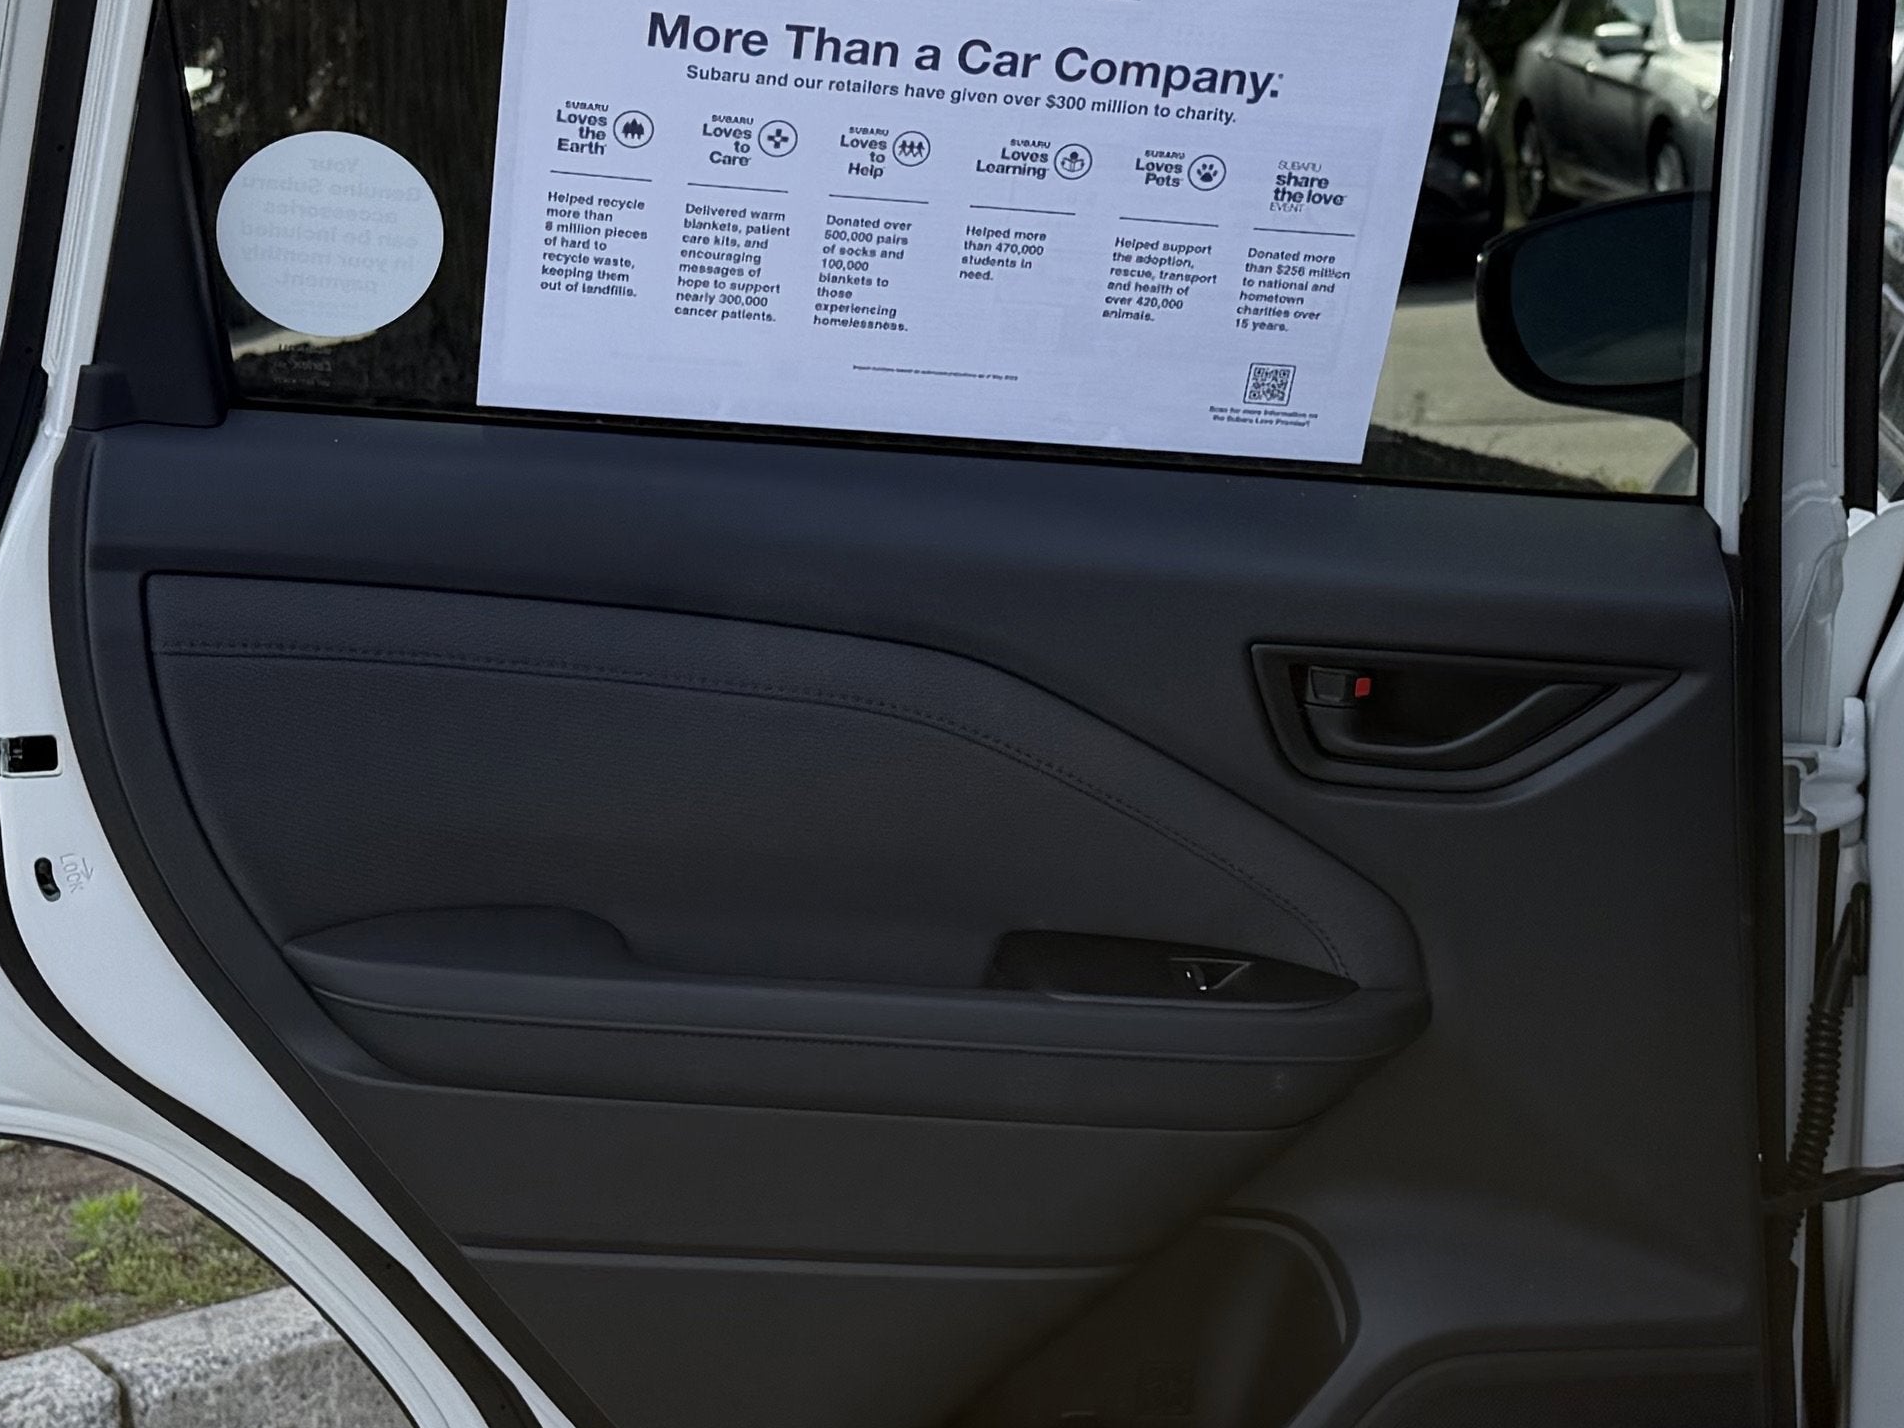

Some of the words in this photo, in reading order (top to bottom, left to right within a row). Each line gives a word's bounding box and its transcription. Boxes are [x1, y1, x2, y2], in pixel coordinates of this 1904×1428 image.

[648, 12, 768, 57] More
[786, 24, 899, 68] Than
[915, 45, 941, 71] a
[958, 39, 1041, 78] Car
[687, 65, 750, 83] Subaru
[755, 73, 788, 87] and
[794, 77, 823, 89] our
[829, 79, 899, 96] retailers
[904, 84, 945, 99] have
[950, 88, 997, 104] given
[1003, 94, 1041, 107] over
[1045, 94, 1086, 111] $300
[1091, 99, 1148, 116] million
[1154, 103, 1170, 117] to
[1176, 105, 1235, 125] charity.
[565, 101, 609, 112] SUBARU
[557, 109, 607, 127] Loves
[712, 115, 754, 125] SUBARU
[578, 126, 606, 140] the
[703, 123, 752, 140] Loves
[849, 127, 889, 137] SUBARU
[557, 138, 607, 155] Earth
[734, 141, 750, 153] to
[840, 134, 887, 151] Loves
[1010, 139, 1051, 149] SUBARU
[709, 152, 751, 166] Care
[869, 151, 885, 163] to
[1001, 147, 1048, 163] Loves
[1145, 150, 1185, 160] SUBARU
[848, 162, 885, 179] Help
[976, 160, 1050, 180] Learning
[1135, 158, 1183, 174] Loves
[1278, 160, 1322, 173] SUBARU
[1145, 173, 1183, 187] Pets
[1276, 171, 1329, 189] share
[548, 191, 594, 206] Helped
[598, 198, 645, 210] recycle
[1274, 187, 1304, 203] the
[1306, 189, 1347, 206] love
[547, 208, 580, 219] more
[584, 209, 613, 222] than
[686, 203, 747, 218] Delivered
[751, 211, 785, 221] warm
[1270, 202, 1305, 212] EVENT
[557, 222, 601, 236] million
[604, 226, 647, 239] pieces
[684, 218, 742, 234] blankets,
[745, 224, 790, 236] patient
[826, 214, 880, 228] Donated
[884, 221, 912, 231] over
[825, 229, 873, 243] 500,000
[876, 234, 908, 246] pairs
[966, 225, 1010, 240] Helped
[1014, 231, 1046, 241] more
[544, 236, 557, 246] of
[561, 236, 590, 250] hard
[594, 240, 607, 251] to
[682, 235, 710, 245] care
[713, 235, 740, 249] kits,
[744, 239, 768, 249] and
[964, 240, 992, 252] than
[995, 242, 1044, 256] 470,000
[1115, 237, 1160, 251] Helped
[1162, 243, 1212, 256] support
[681, 249, 761, 265] encouraging
[823, 244, 836, 254] of
[839, 246, 876, 258] socks
[880, 250, 904, 259] and
[1248, 248, 1300, 261] Donated
[1303, 254, 1335, 264] more
[543, 252, 590, 265] recycle
[593, 256, 634, 269] waste,
[822, 258, 869, 271] 100,000
[962, 255, 1016, 268] students
[1021, 258, 1032, 269] in
[1113, 252, 1133, 263] the
[1135, 254, 1194, 270] adoption,
[542, 264, 593, 281] keeping
[597, 269, 629, 282] them
[679, 264, 744, 278] messages
[748, 268, 761, 278] of
[959, 270, 993, 280] need.
[1110, 268, 1156, 281] rescue,
[1159, 270, 1217, 285] transport
[1245, 262, 1273, 274] than
[1308, 267, 1350, 279] million
[677, 276, 710, 290] hope
[714, 279, 726, 290] to
[729, 282, 780, 295] support
[819, 272, 872, 286] blankets
[877, 277, 889, 287] to
[1243, 277, 1255, 287] to
[1258, 279, 1309, 291] national
[1311, 283, 1335, 293] and
[540, 281, 561, 290] out
[565, 281, 579, 292] of
[582, 282, 636, 297] landfills.
[817, 286, 852, 299] those
[1107, 280, 1132, 291] and
[1134, 281, 1173, 295] health
[1176, 286, 1190, 296] of
[676, 292, 716, 305] nearly
[719, 293, 768, 307] 300,000
[1105, 296, 1133, 306] over
[1136, 296, 1183, 309] 420,000
[1239, 290, 1304, 305] hometown
[674, 307, 718, 317] cancer
[721, 309, 776, 321] patients.
[815, 303, 896, 319] experiencing
[1102, 308, 1154, 321] animals.
[1237, 304, 1290, 318] charities
[1293, 310, 1321, 320] over
[813, 315, 908, 331] homelessness.
[1236, 318, 1249, 329] 15
[1252, 321, 1288, 332] years.
[60, 853, 83, 894] LOCK
